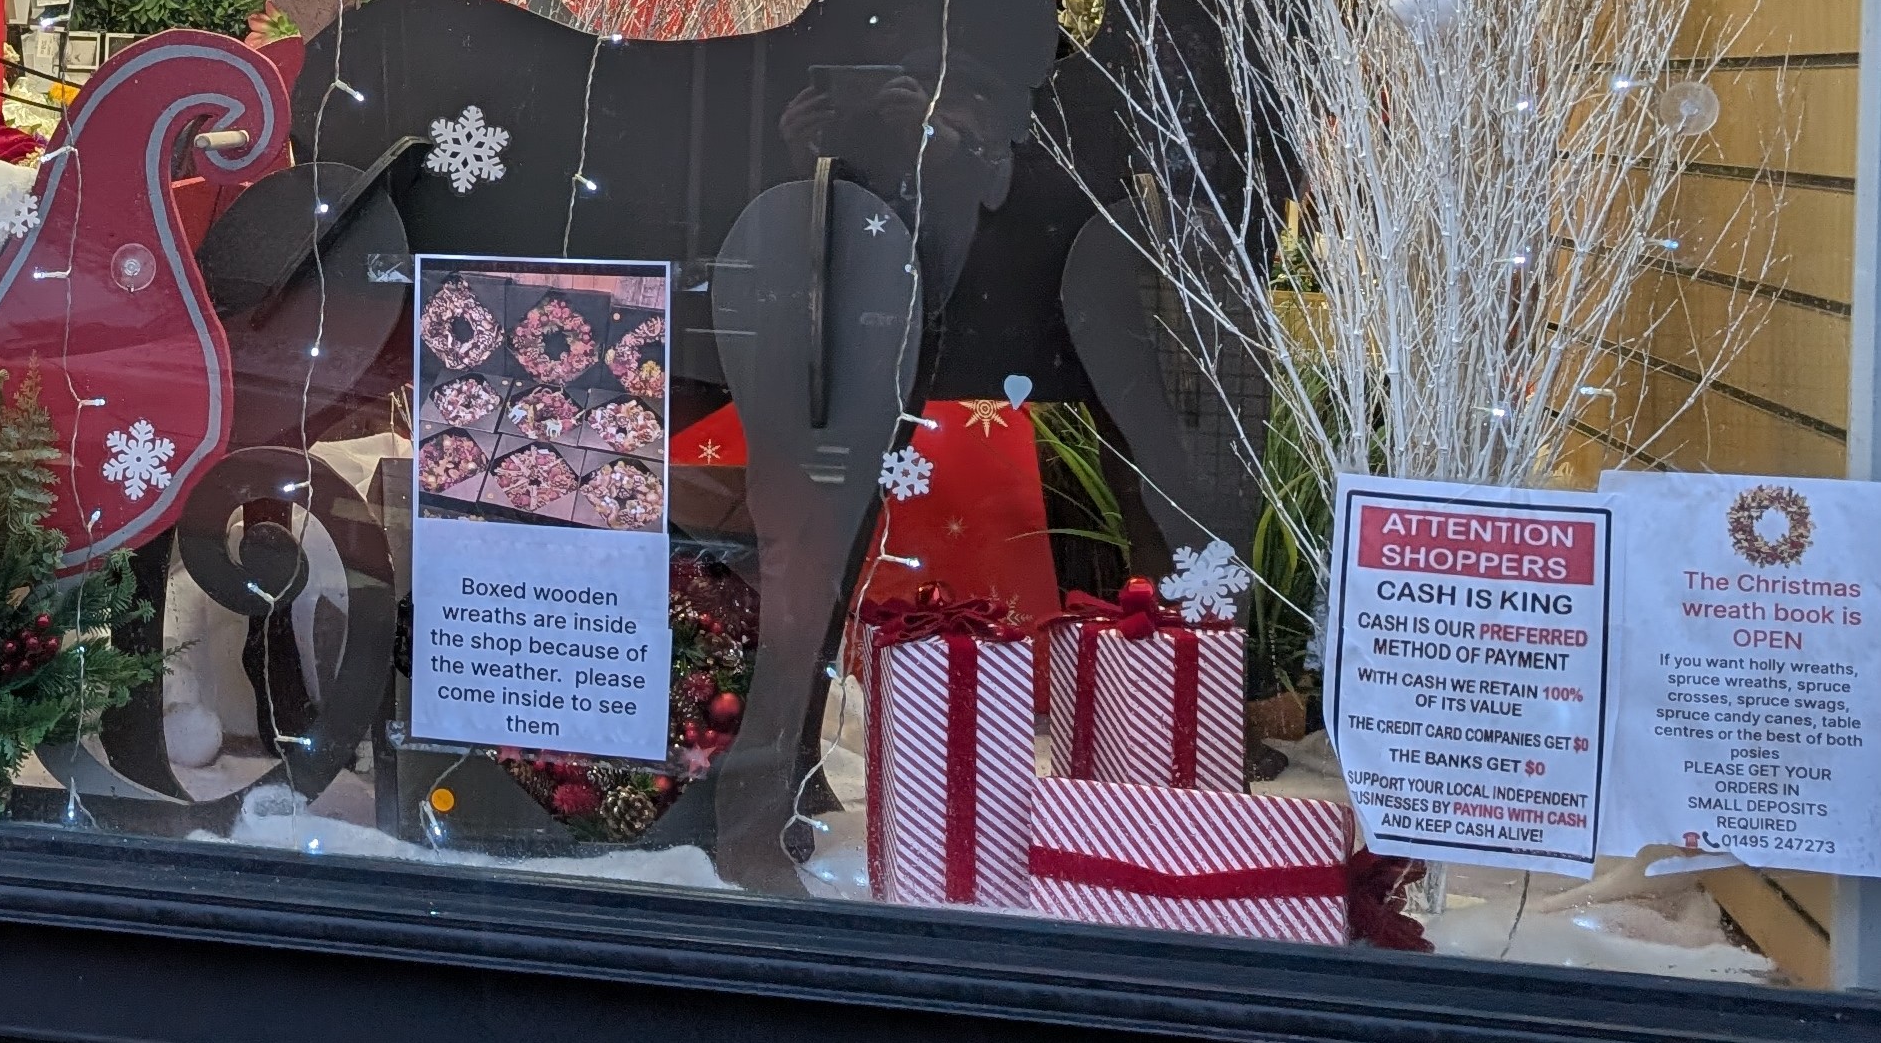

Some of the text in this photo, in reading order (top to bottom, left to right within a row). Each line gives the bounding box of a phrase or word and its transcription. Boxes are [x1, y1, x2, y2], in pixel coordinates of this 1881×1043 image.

[1382, 512, 1573, 548] ATTENTION
[1381, 544, 1567, 580] SHOPPERS
[461, 577, 618, 607] Boxed wooden
[1377, 580, 1573, 615] CASH IS KING
[1683, 570, 1861, 598] The Christmas
[442, 605, 637, 635] wreaths are inside
[1681, 601, 1862, 626] wreath book is
[1357, 611, 1589, 648] CASH IS OUR PREFERRED
[1733, 628, 1803, 651] OPEN
[429, 628, 649, 663] the shop because of
[1373, 637, 1570, 671] METHOD OF PAYMENT
[430, 654, 646, 690] the weather. please
[1660, 653, 1857, 677] If you want holly wreaths,
[1357, 667, 1584, 703] WITH CASH WE RETAIN 100%
[1667, 674, 1851, 695] spruce wreaths, spruce
[437, 685, 637, 716] come inside to see
[1415, 693, 1523, 717] OF ITS VALUE
[1667, 691, 1850, 714] crosses, spruce swags,
[506, 714, 560, 737] them
[1347, 714, 1589, 753] THE CREDIT CARD COMPANIES GET $0
[1656, 708, 1862, 730] spruce candy canes, table
[1654, 725, 1863, 747] centres or the best of both
[1388, 747, 1546, 777] THE BANKS GET $0
[1730, 746, 1780, 761] posies
[1684, 760, 1832, 781] PLEASE GET YOUR
[1347, 770, 1589, 809] SUPPORT YOUR LOCAL INDEPENDENT
[1714, 780, 1800, 797] ORDERS IN
[1432, 799, 1451, 815] BY
[1453, 801, 1504, 820] PAYING
[1507, 806, 1544, 824] WITH
[1547, 810, 1587, 829] CASH
[1688, 796, 1828, 817] SMALL DEPOSITS
[1381, 813, 1544, 843] AND KEEP CASH ALIVE!
[1716, 815, 1797, 832] REQUIRED
[1721, 833, 1836, 854] 01495 247273
